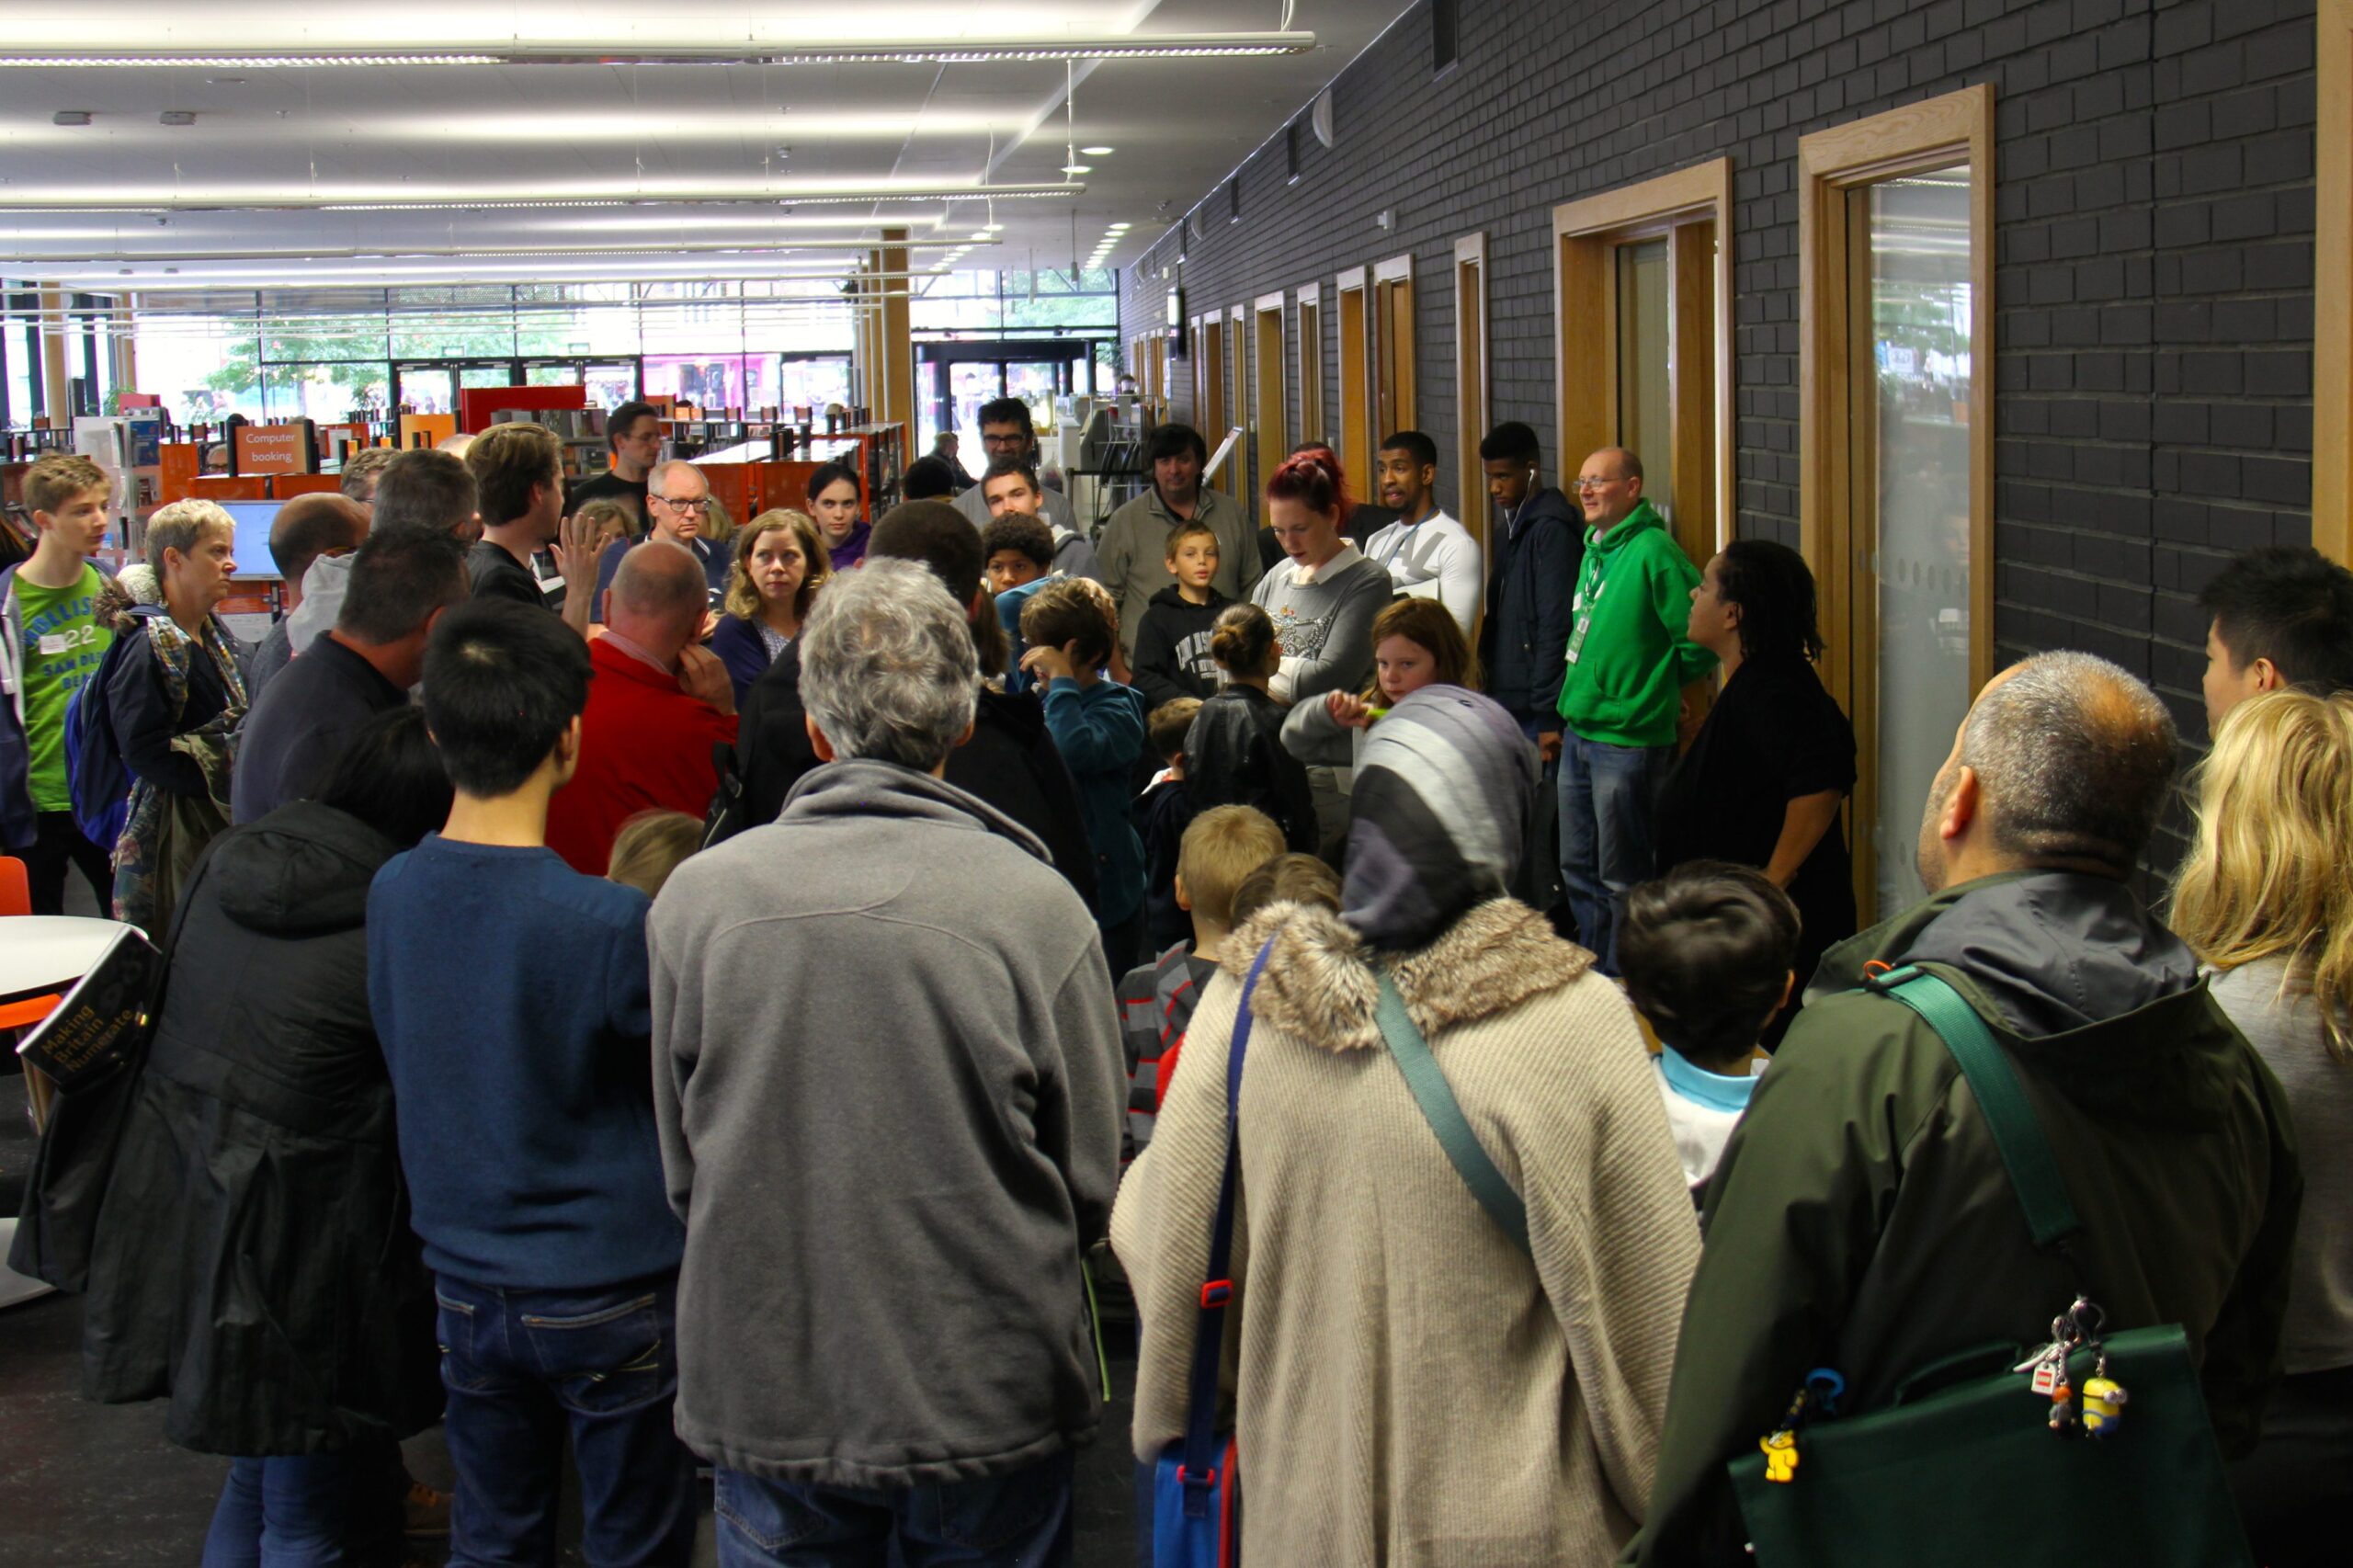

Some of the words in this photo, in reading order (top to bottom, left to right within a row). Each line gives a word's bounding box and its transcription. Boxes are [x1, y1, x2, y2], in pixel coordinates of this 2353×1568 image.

[245, 434, 296, 445] Computer
[251, 451, 292, 463] booking
[41, 1005, 95, 1055] Making
[53, 1018, 104, 1064] Britain
[65, 1010, 132, 1073] Numerate
